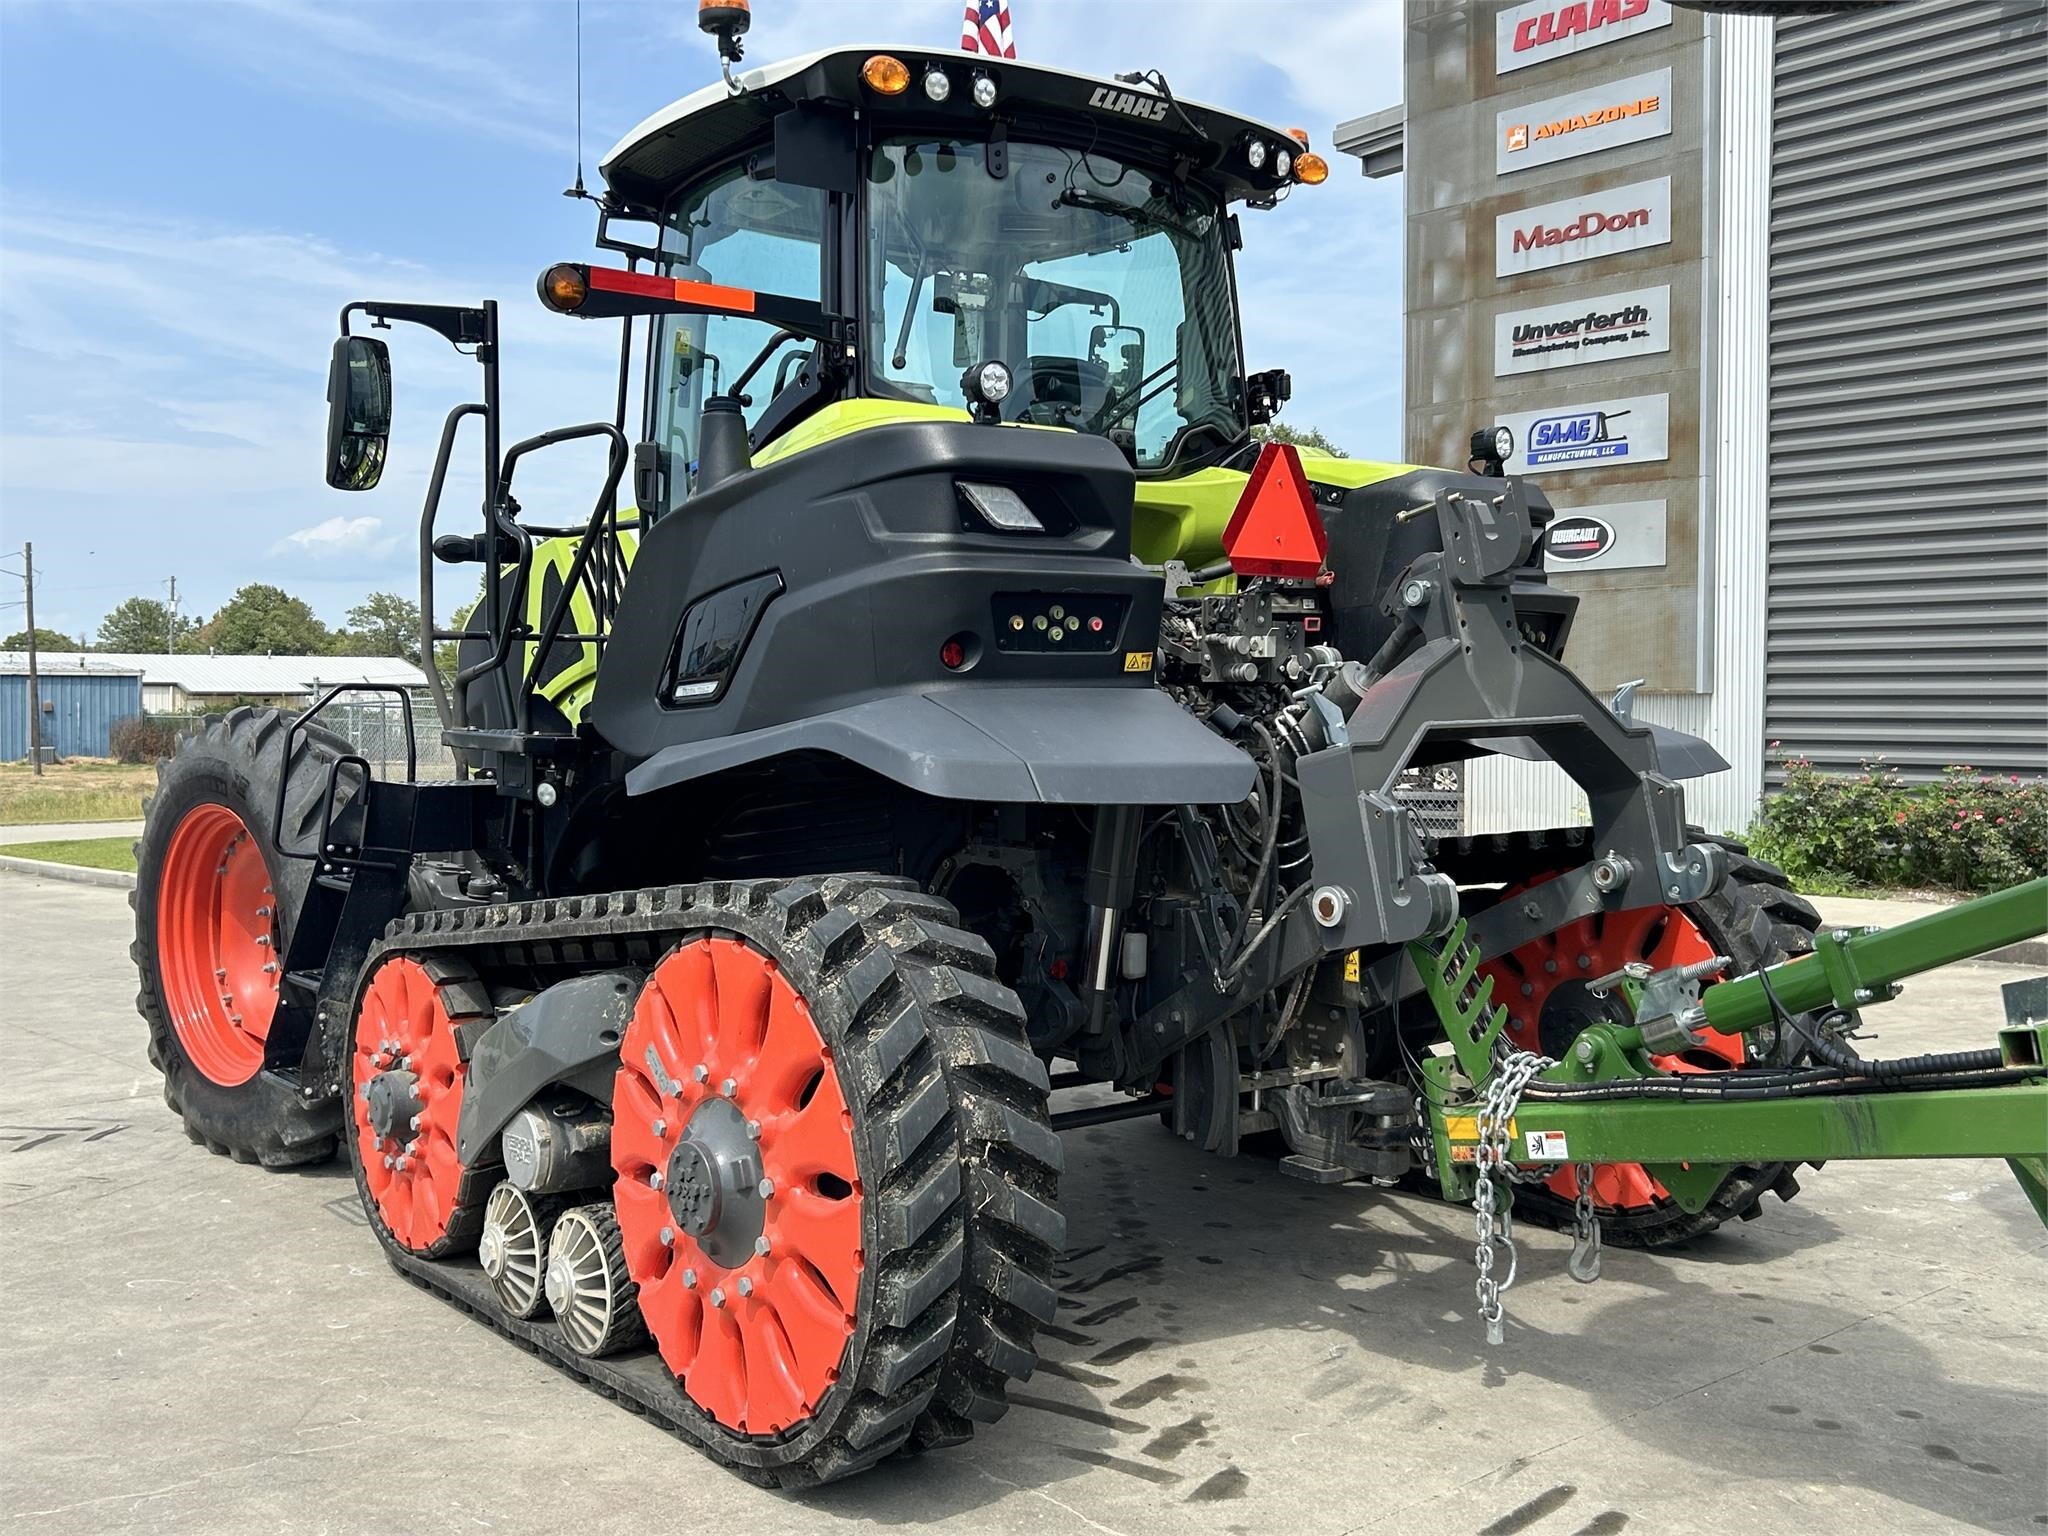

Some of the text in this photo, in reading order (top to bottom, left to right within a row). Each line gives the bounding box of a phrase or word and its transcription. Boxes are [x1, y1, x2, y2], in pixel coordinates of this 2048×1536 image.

[1513, 0, 1649, 52] CLAAS
[1088, 87, 1170, 121] CLAAS
[1533, 96, 1659, 141] AMAZONE
[1513, 208, 1650, 253] MacDon
[1512, 305, 1648, 342] Unverferth
[1512, 330, 1650, 357] Manufacturing Company, Inc.
[1537, 446, 1617, 463] MANUFACTURING, LLC
[1551, 527, 1600, 544] BOURGAULT
